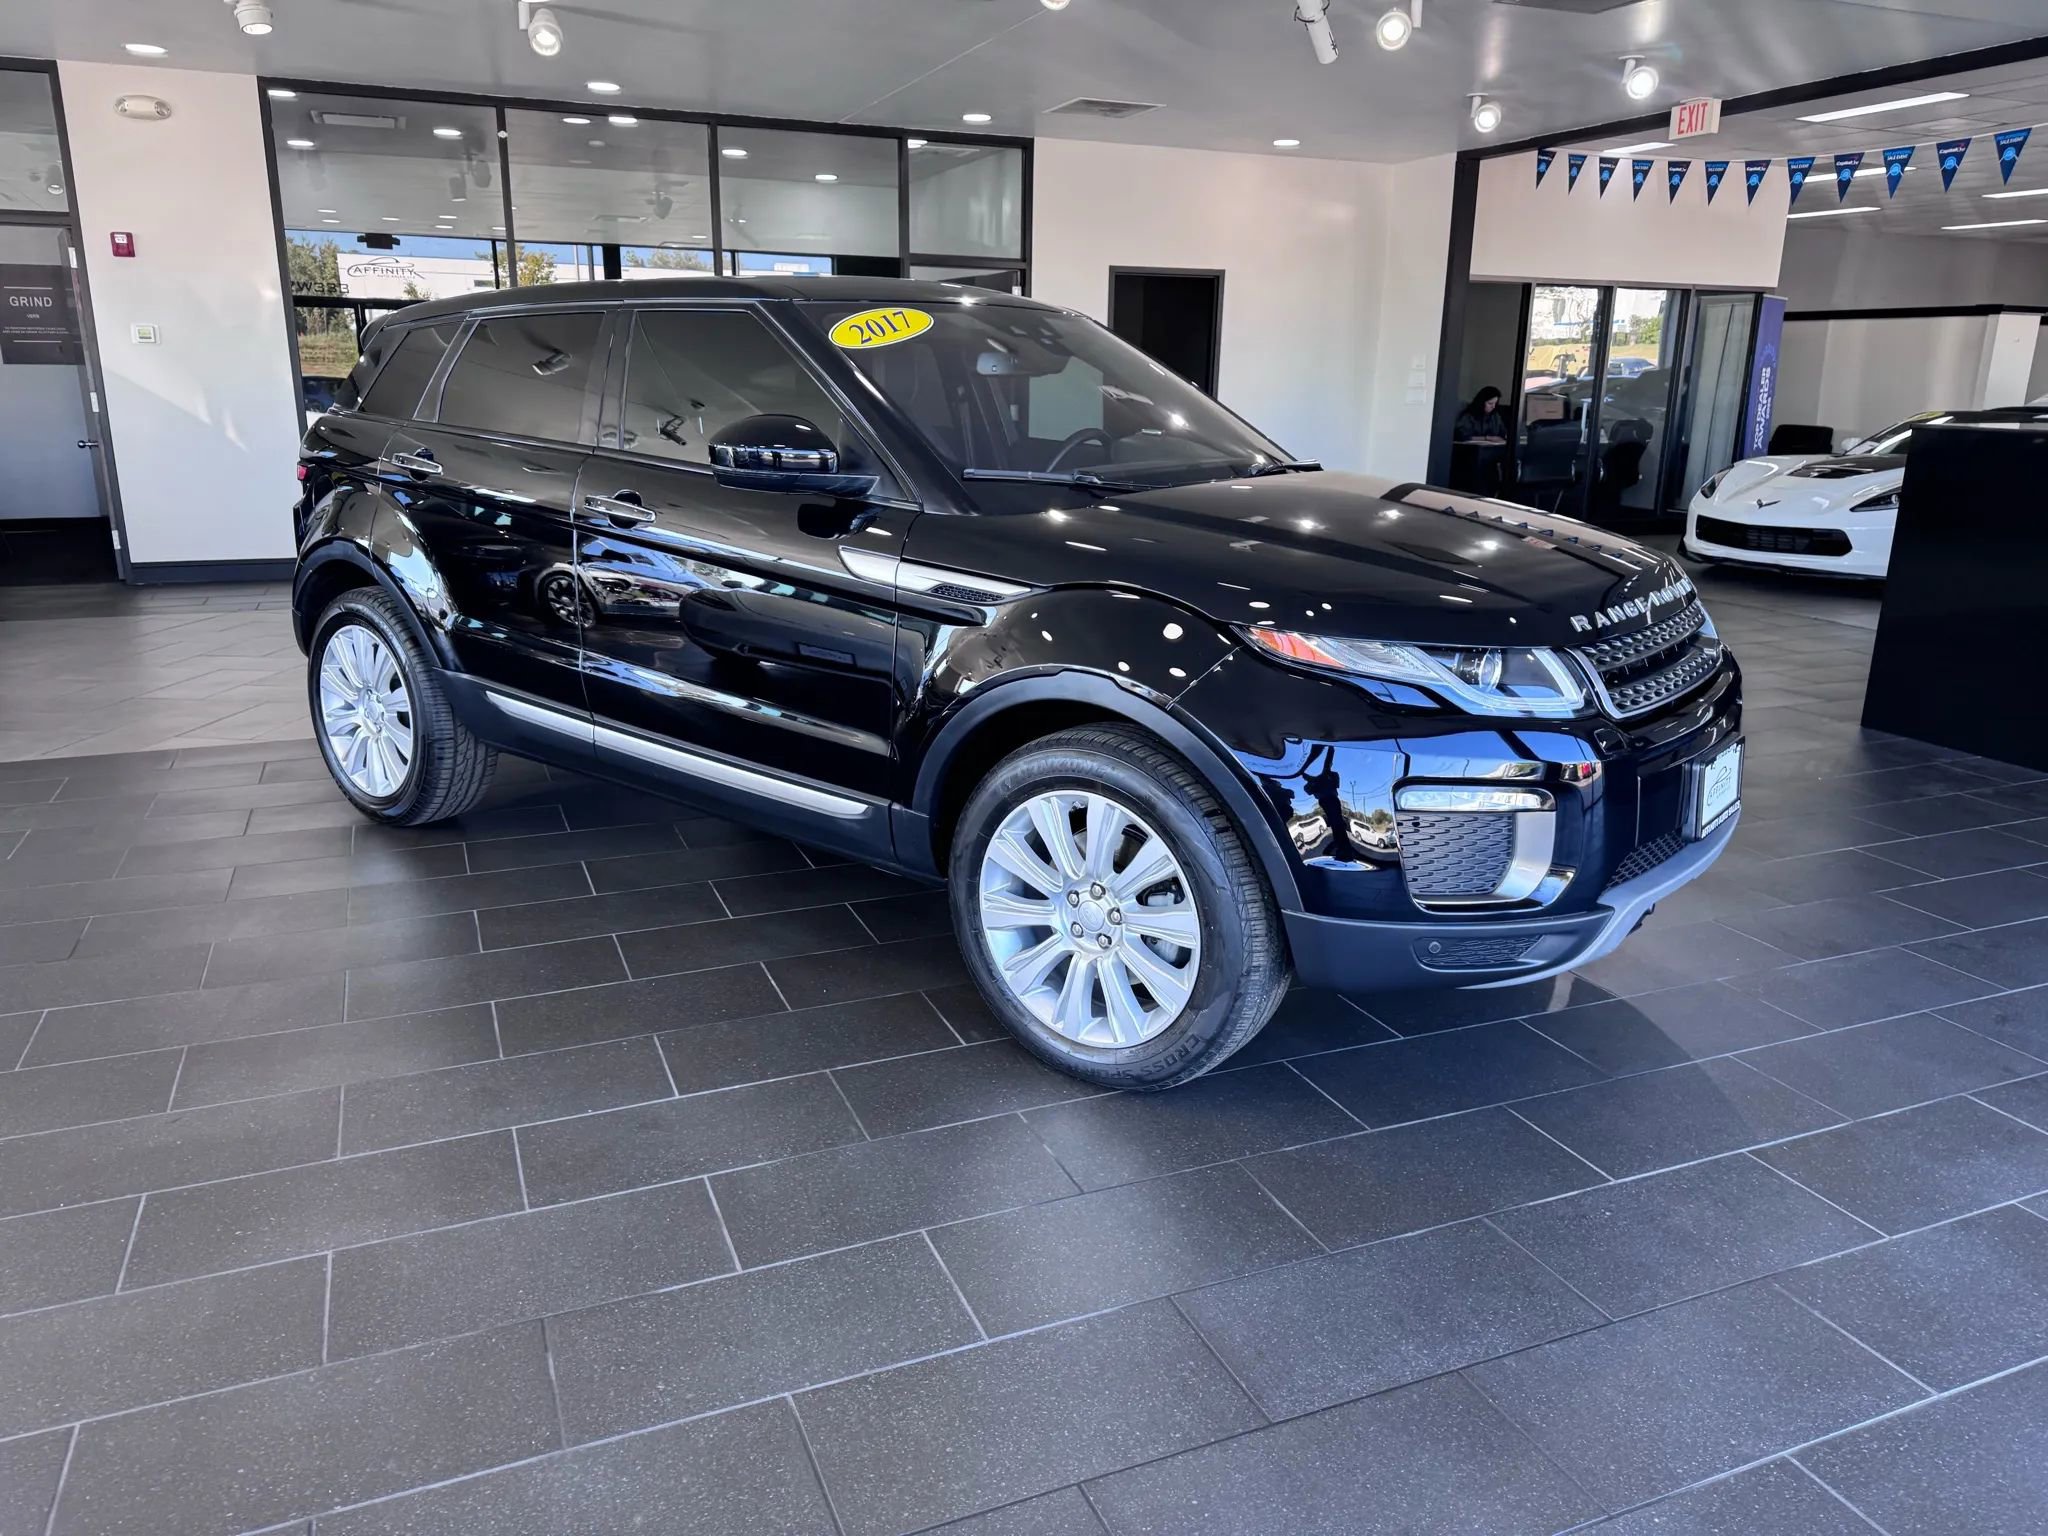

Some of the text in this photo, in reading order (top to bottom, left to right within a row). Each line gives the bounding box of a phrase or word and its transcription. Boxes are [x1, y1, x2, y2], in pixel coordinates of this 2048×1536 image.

[1677, 102, 1708, 135] EXIT
[353, 266, 415, 276] AFFINITY
[9, 296, 53, 308] GRIND
[848, 310, 911, 345] 2017
[1756, 367, 1767, 422] DEALER
[1757, 366, 1771, 449] AWARDS
[1569, 597, 1648, 633] RANGE
[1140, 1033, 1201, 1077] CROSS
